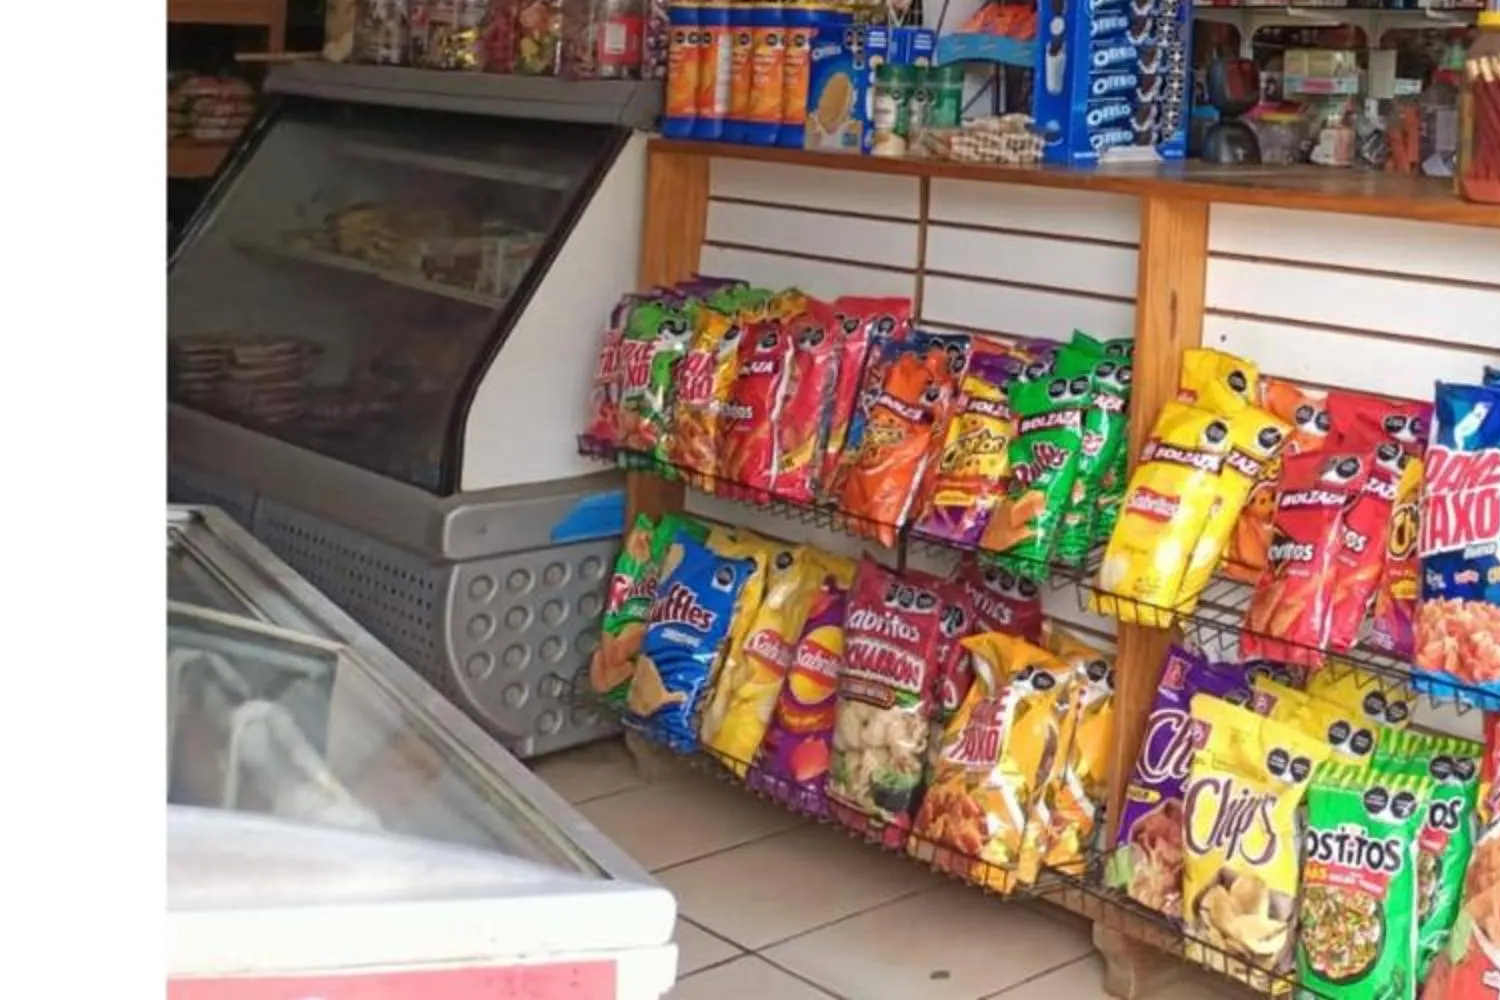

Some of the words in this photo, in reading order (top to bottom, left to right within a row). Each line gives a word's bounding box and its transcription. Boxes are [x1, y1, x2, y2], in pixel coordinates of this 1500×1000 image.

[649, 583, 714, 630] uffles
[849, 608, 920, 642] abritas
[1183, 778, 1277, 865] Chips
[1307, 827, 1402, 872] OSTiTOS
